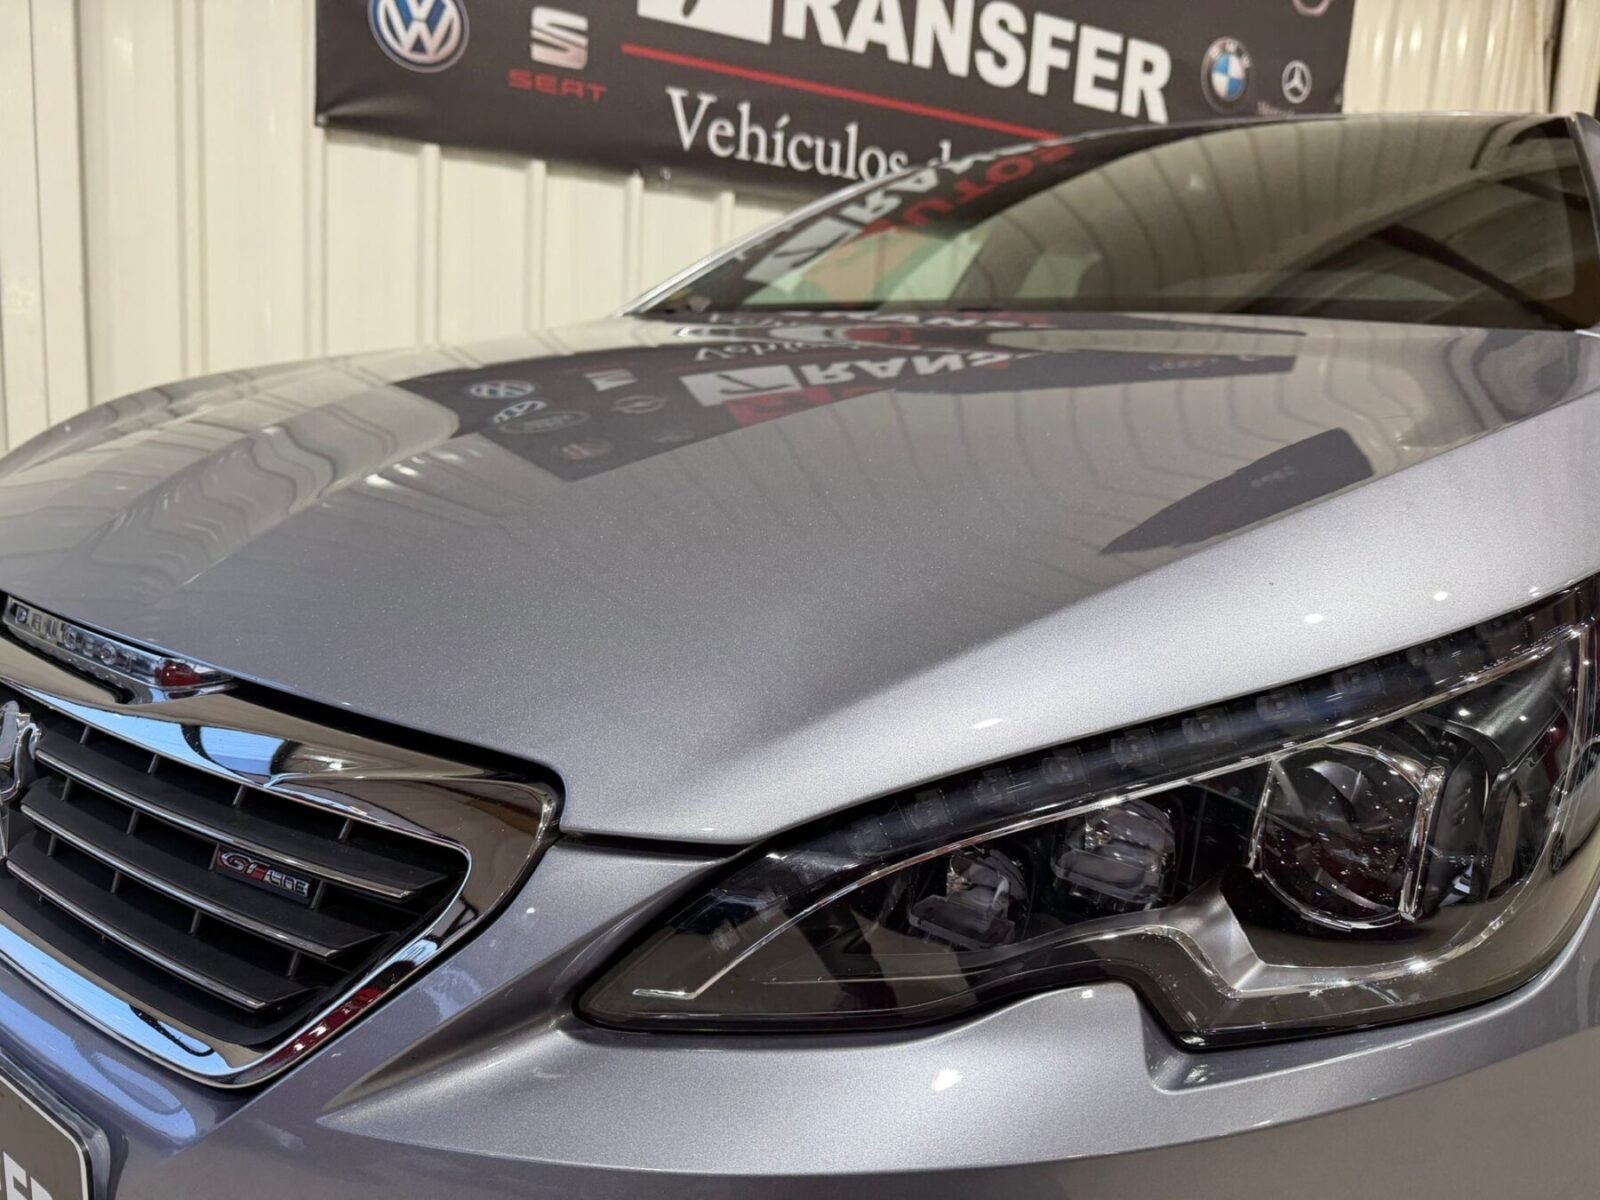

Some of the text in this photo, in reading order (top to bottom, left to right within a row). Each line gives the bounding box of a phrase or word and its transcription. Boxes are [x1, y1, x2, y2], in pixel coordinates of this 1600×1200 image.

[508, 69, 608, 102] SEAT
[637, 0, 1169, 125] RANSFER
[665, 86, 909, 182] Vehículos
[221, 852, 270, 875] GT
